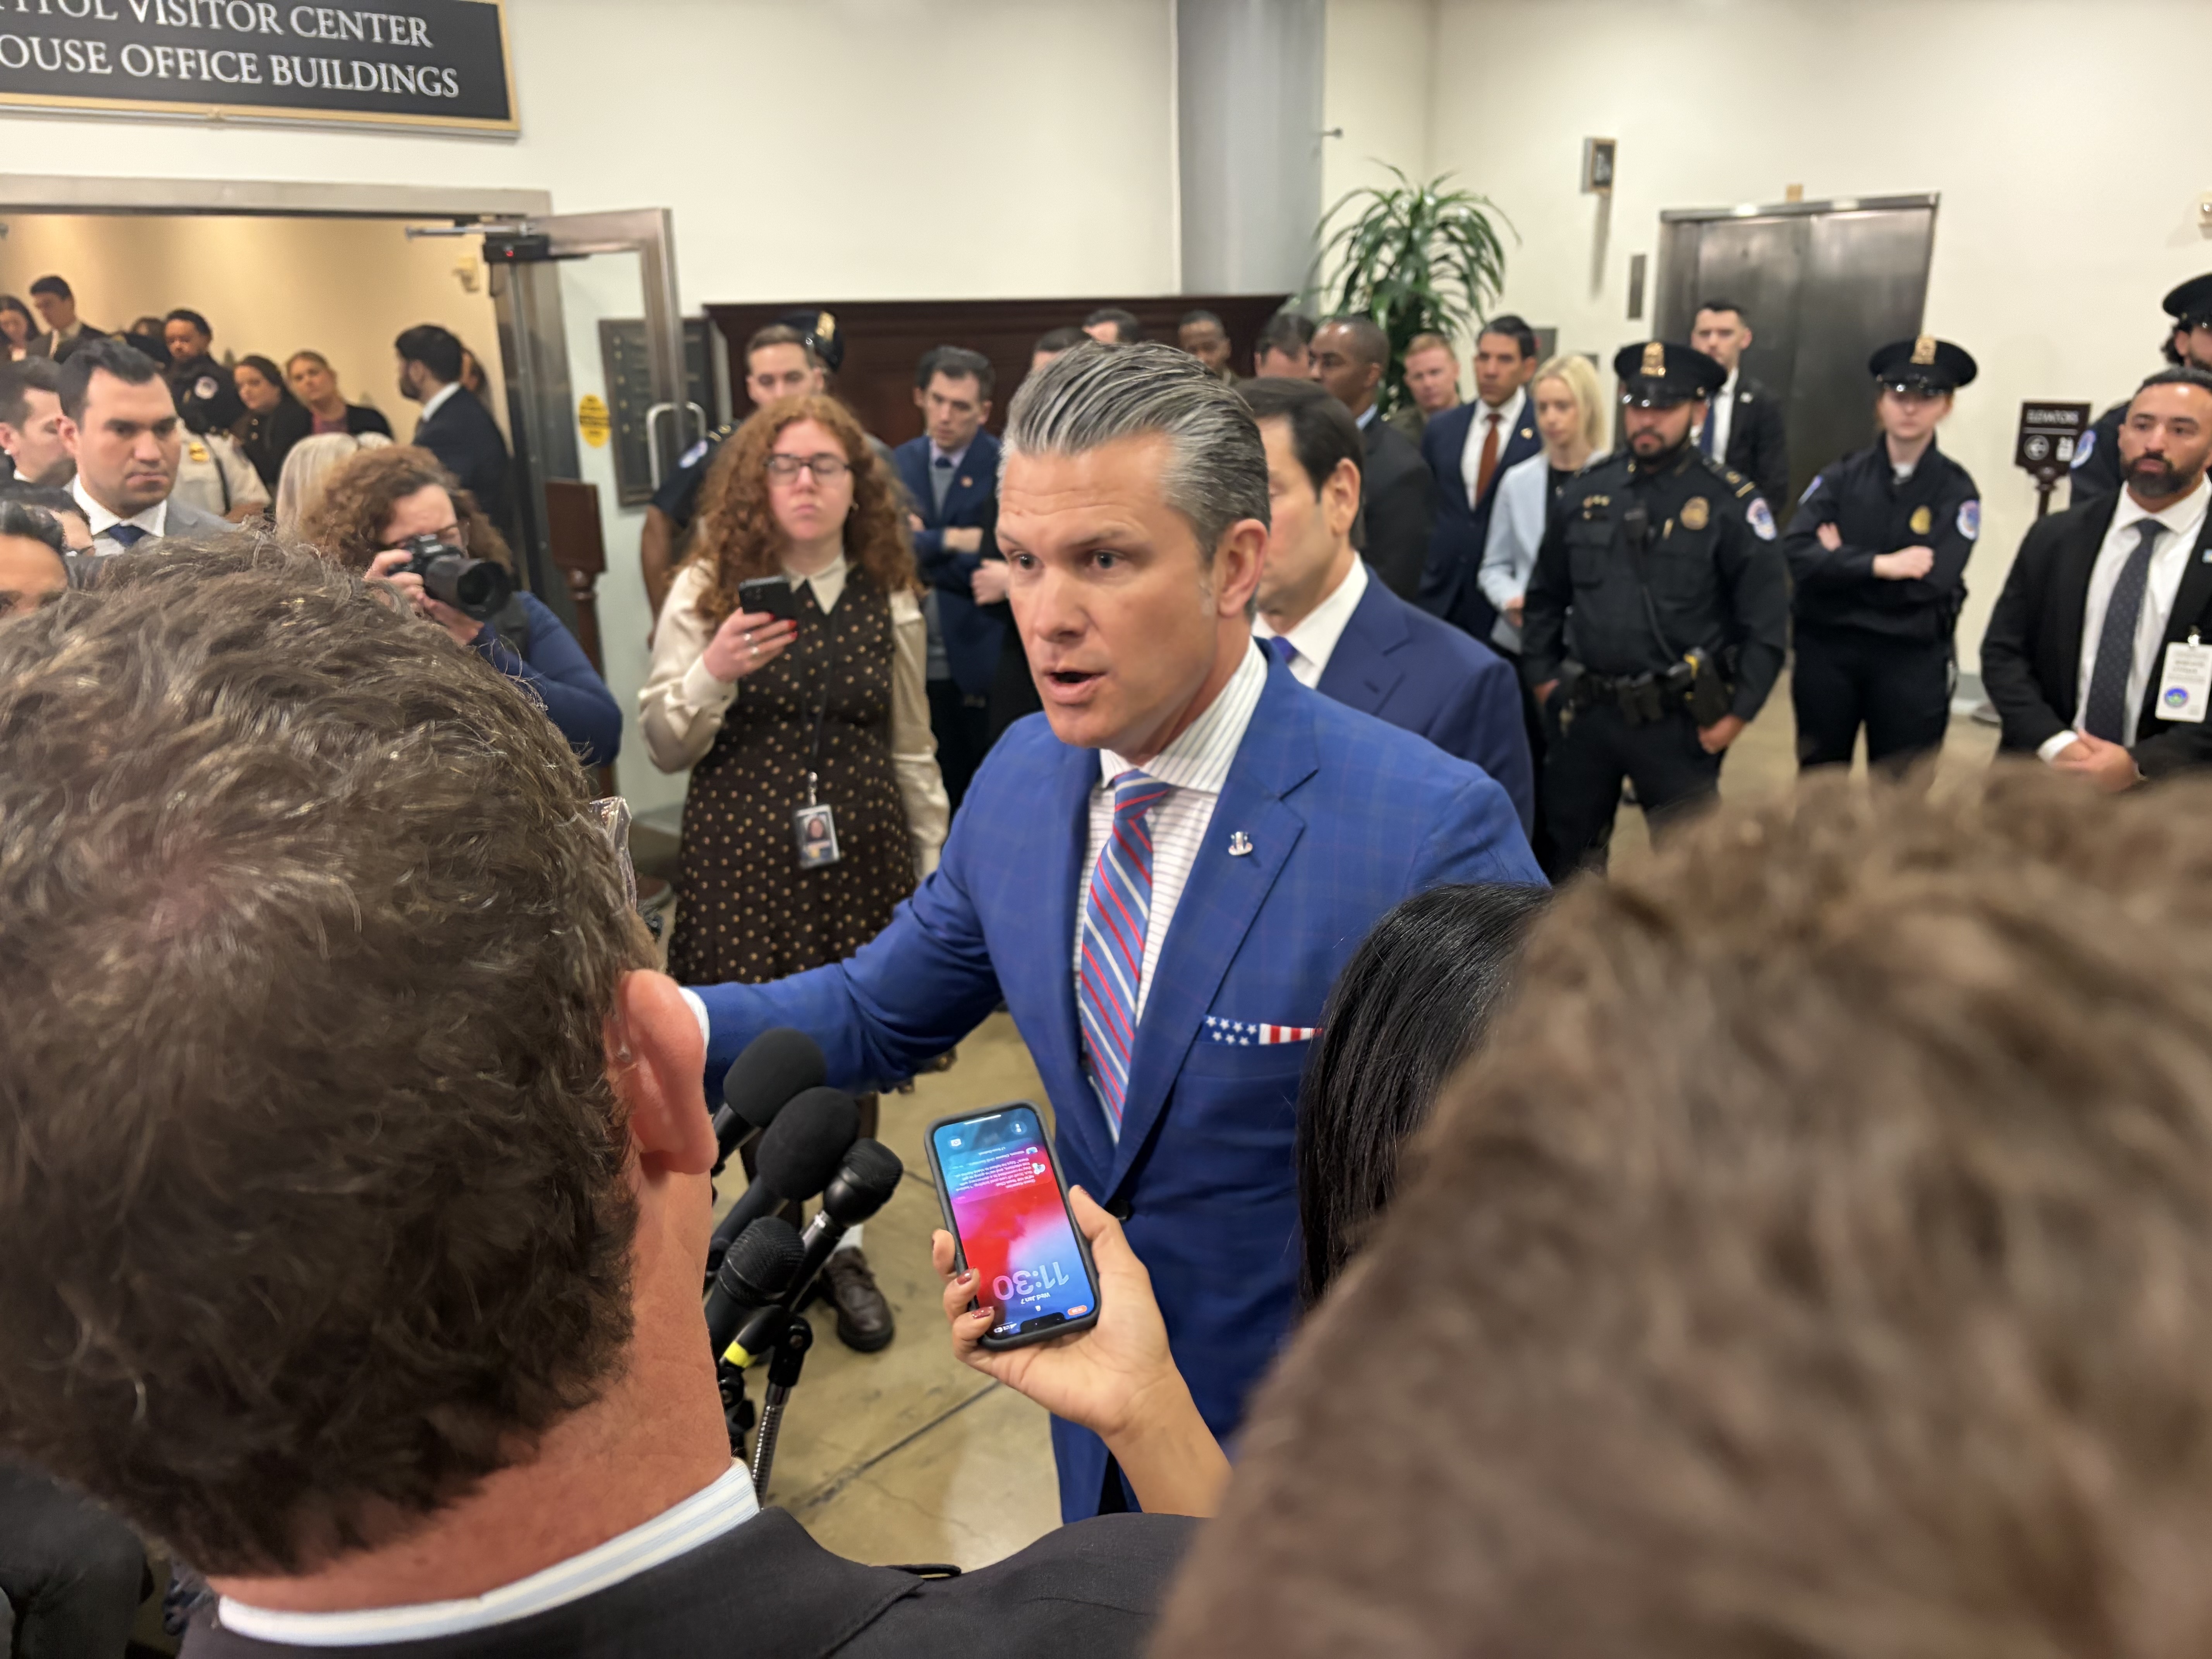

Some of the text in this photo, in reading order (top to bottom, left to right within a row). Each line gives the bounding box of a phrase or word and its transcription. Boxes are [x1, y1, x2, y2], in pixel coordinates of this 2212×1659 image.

[129, 0, 284, 35] VISITOR
[290, 6, 434, 48] CENTER
[121, 43, 262, 83] OFFICE
[268, 54, 459, 98] BUILDINGS
[993, 1262, 1069, 1300] 11:30
[1036, 1292, 1051, 1300] Wed
